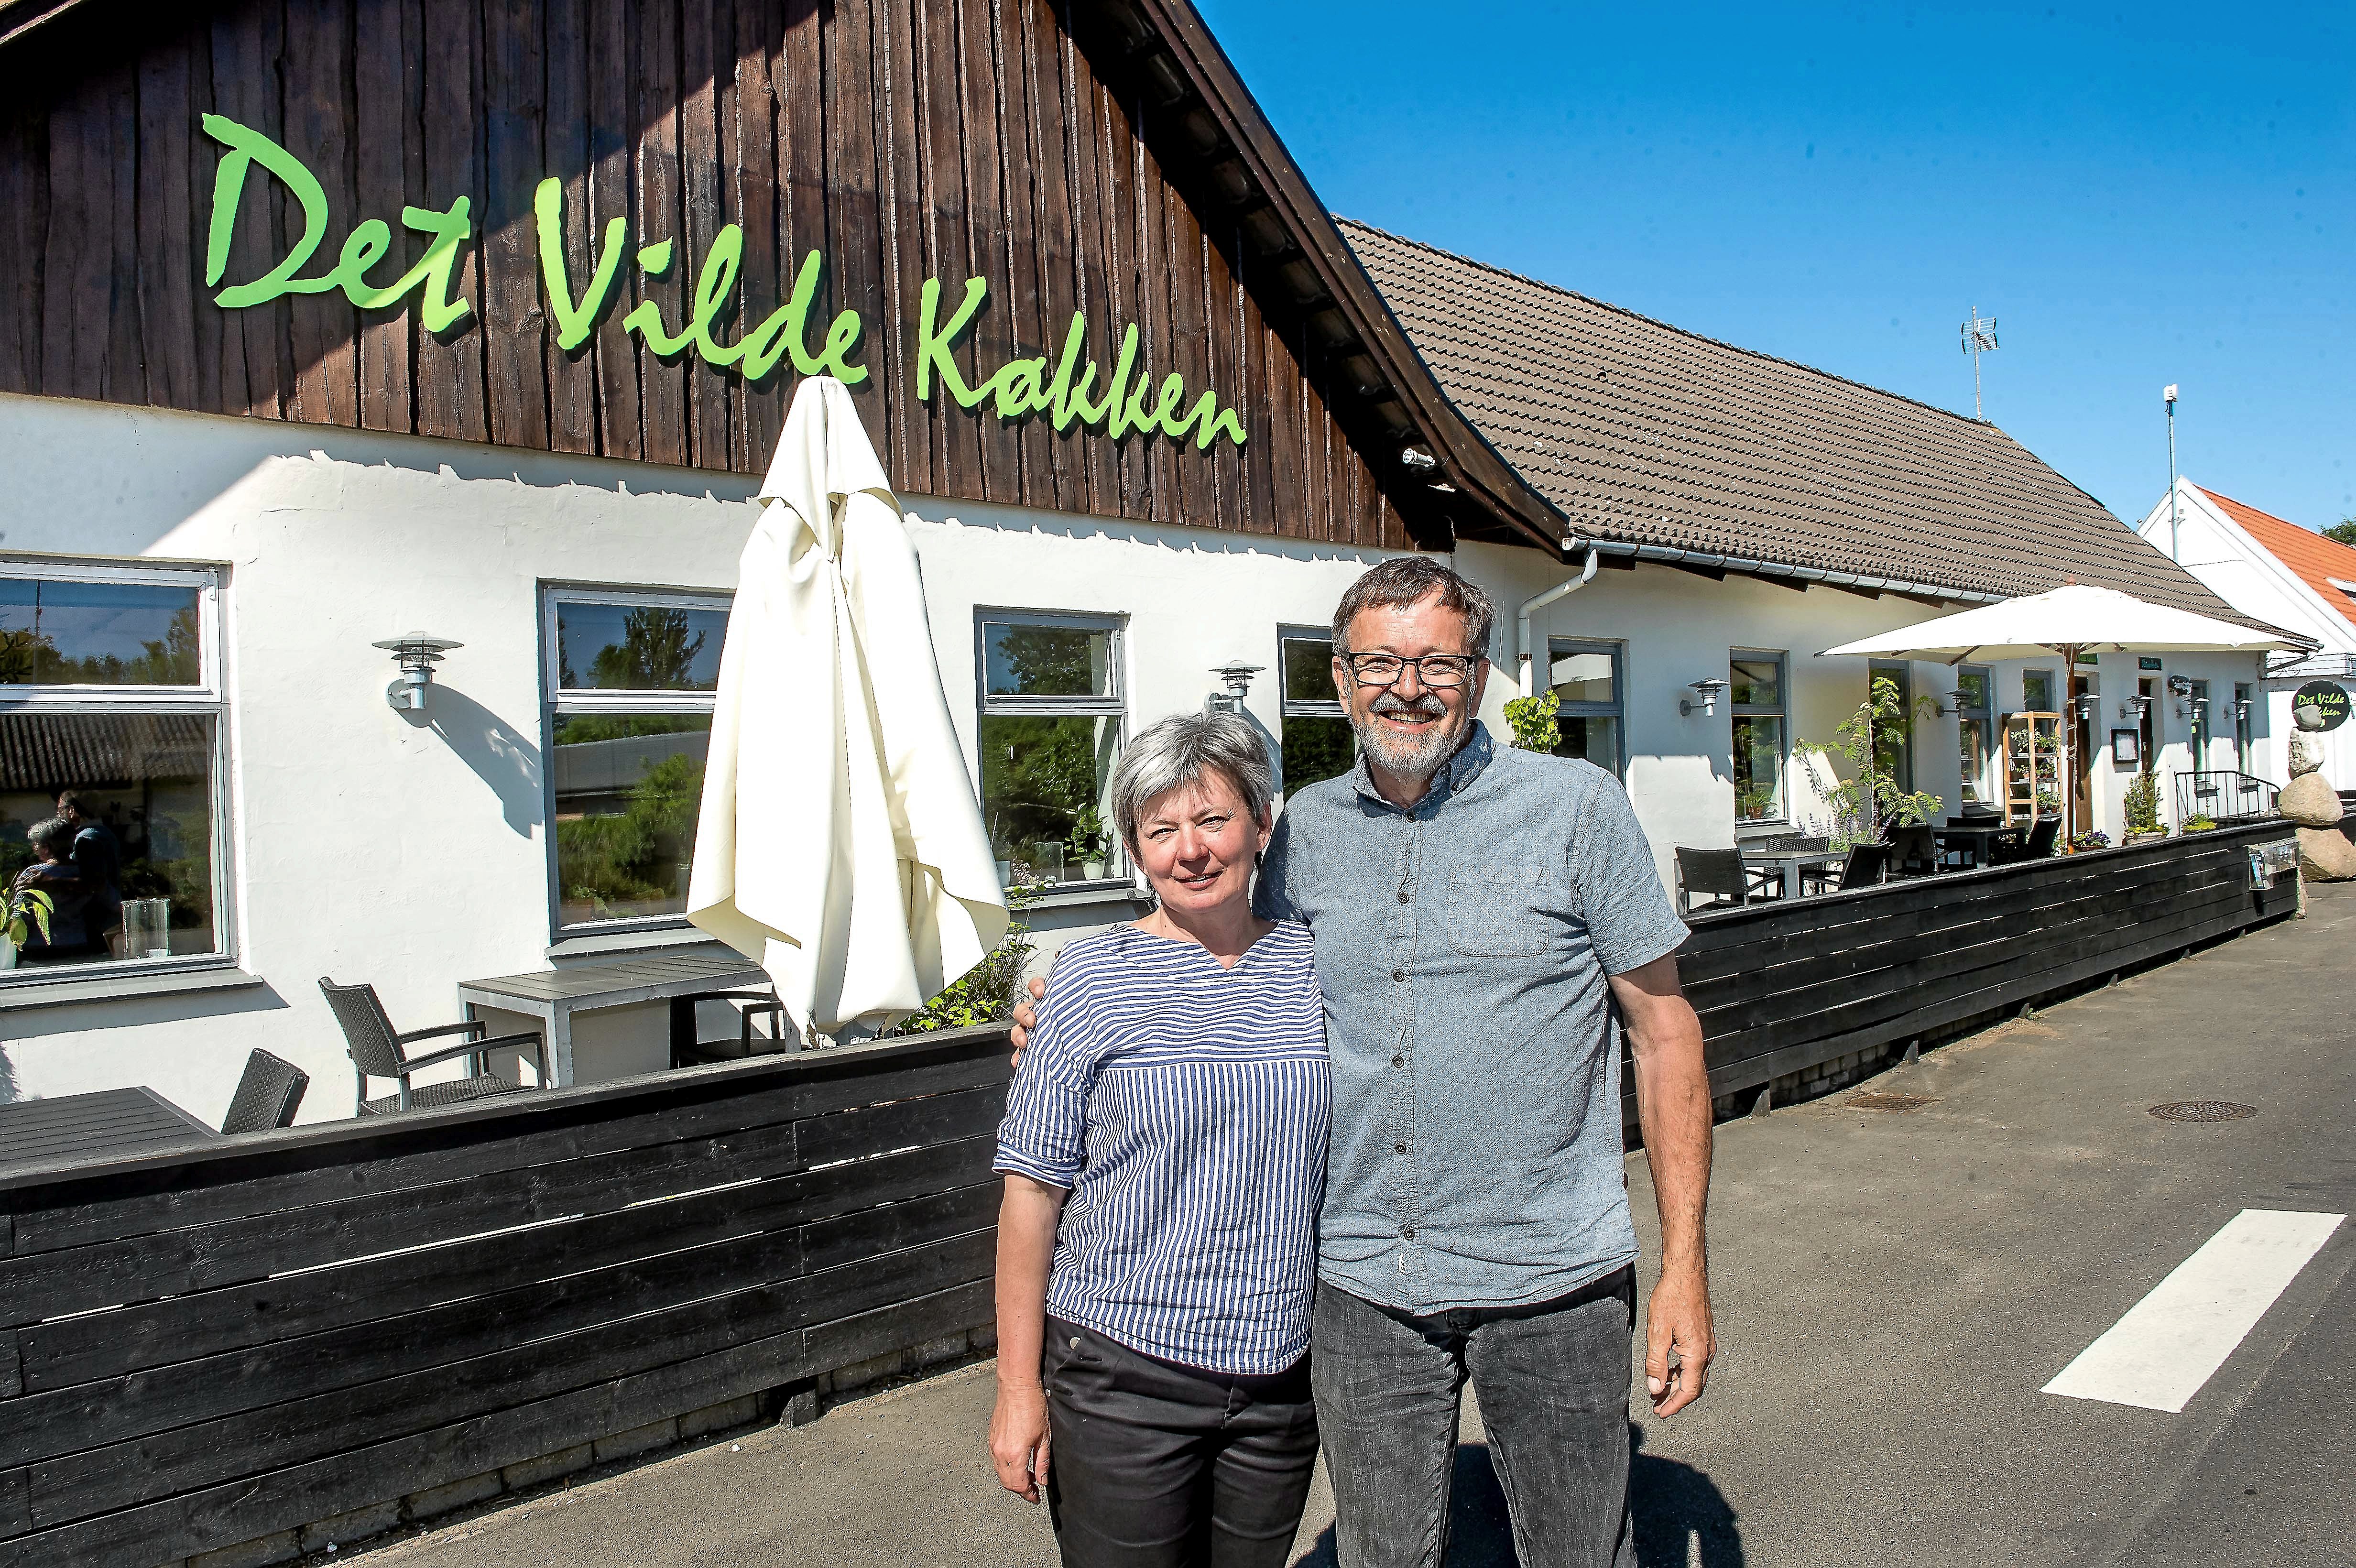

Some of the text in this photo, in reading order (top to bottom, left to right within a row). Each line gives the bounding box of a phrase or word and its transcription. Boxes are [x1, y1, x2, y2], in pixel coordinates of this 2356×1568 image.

[203, 113, 1246, 449] Det Vilde Køkken
[2298, 693, 2345, 706] Det Vilde
